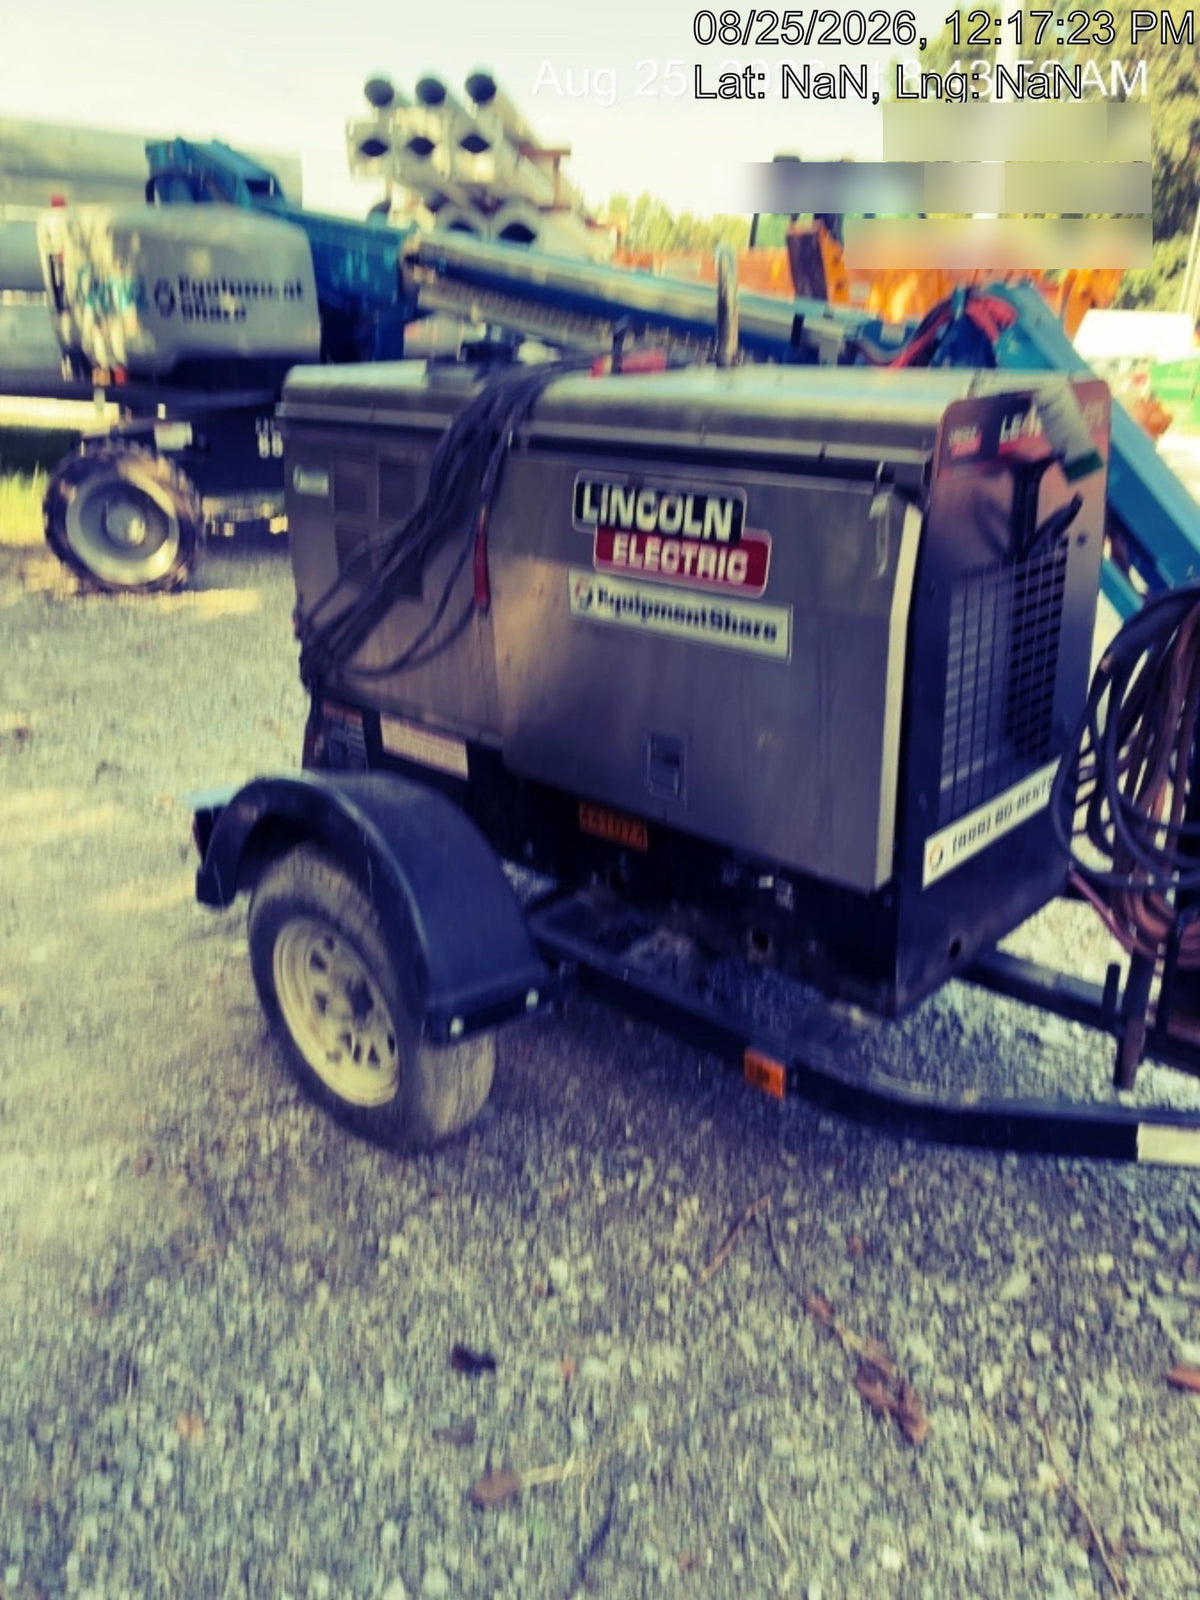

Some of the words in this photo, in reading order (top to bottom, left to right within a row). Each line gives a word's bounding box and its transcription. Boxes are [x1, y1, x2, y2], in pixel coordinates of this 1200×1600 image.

[582, 482, 734, 543] LINCOLN
[611, 530, 749, 585] ELECTRIC
[598, 586, 778, 643] EquipmentShare
